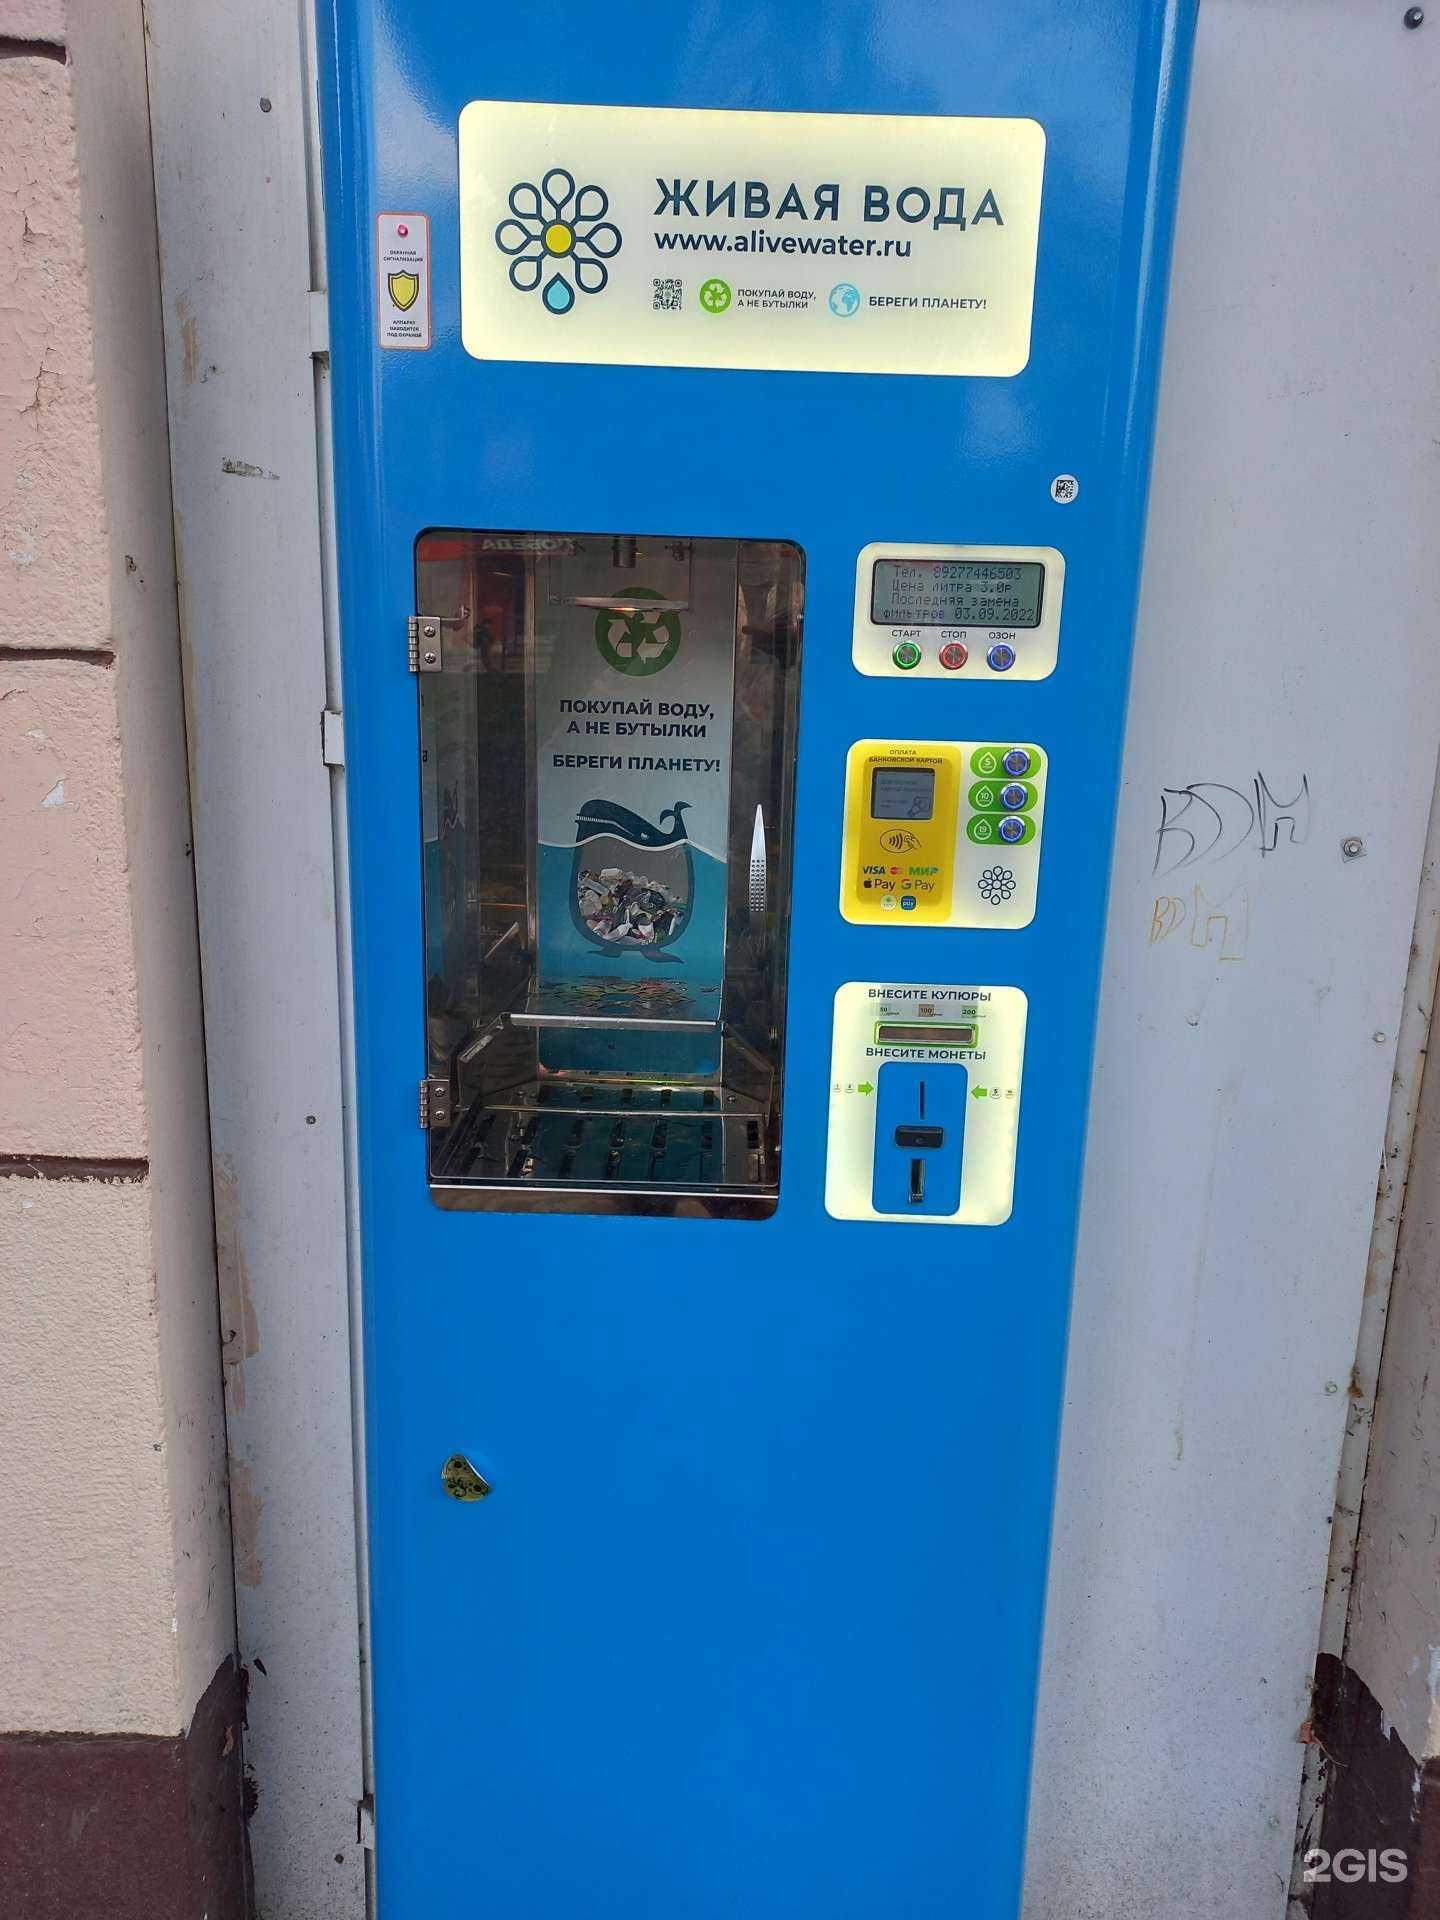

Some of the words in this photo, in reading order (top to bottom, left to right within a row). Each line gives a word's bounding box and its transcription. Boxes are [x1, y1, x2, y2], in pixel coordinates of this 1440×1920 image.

[653, 178, 840, 221] ЖИВАЯ
[863, 185, 1005, 232] ВОДА
[654, 229, 912, 258] www.alivewater.ru
[737, 287, 785, 300] ПОКУПАЙ
[787, 289, 817, 301] ВОДУ,
[737, 299, 746, 308] А
[747, 300, 760, 308] НЕ
[762, 299, 809, 310] БУТЫЛКИ
[868, 296, 919, 309] БЕРЕГИ
[921, 297, 988, 310] ПЛАНЕТУ!
[893, 566, 923, 578] Тел.
[933, 566, 1023, 580] 89277446503
[892, 580, 924, 593] Цена
[932, 582, 973, 593] литра
[891, 593, 964, 607] Последняя
[970, 596, 1019, 608] замена
[953, 607, 1034, 622] 03.09.2022
[891, 629, 922, 638] СТАРТ
[940, 630, 967, 639] СТОП
[988, 631, 1016, 640] ОЗОН
[559, 699, 652, 716] ПОКУПАЙ
[657, 702, 715, 720] ВОДУ,
[566, 720, 580, 735] А
[585, 721, 610, 735] НЕ
[615, 722, 707, 738] БУТЫЛКИ
[552, 754, 622, 769] БЕРЕГИ
[628, 756, 721, 772] ПЛАНЕТУ!
[984, 758, 991, 766] 5
[980, 792, 989, 800] 10
[863, 865, 886, 875] VISA
[908, 866, 939, 876] МИР
[874, 879, 896, 892] Pay
[914, 879, 935, 893] Pay
[868, 988, 927, 1000] ВНЕСИТЕ
[931, 989, 992, 1002] КУПЮРЫ
[865, 1047, 925, 1059] ВНЕСИТЕ
[928, 1048, 986, 1061] МОНЕТЫ
